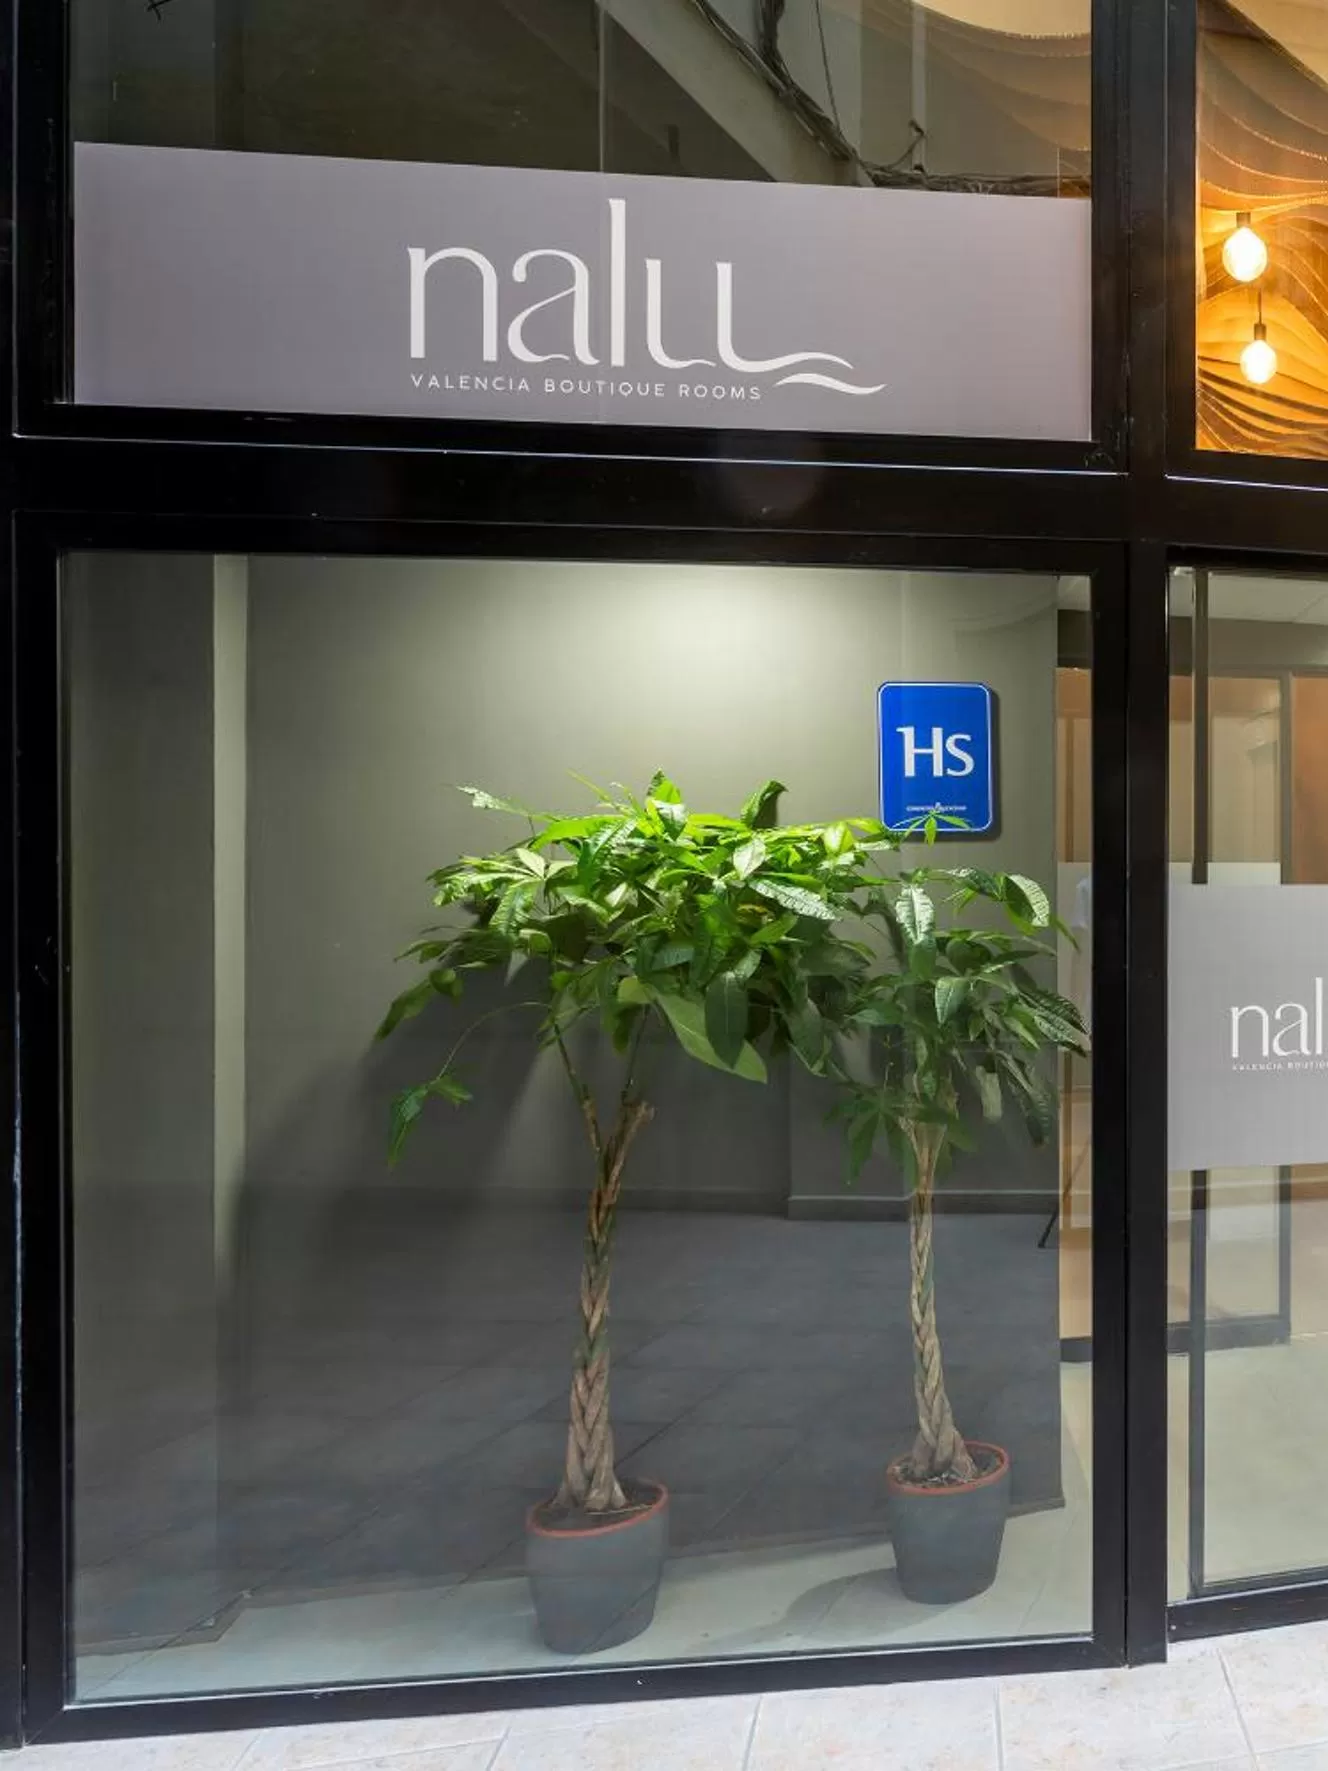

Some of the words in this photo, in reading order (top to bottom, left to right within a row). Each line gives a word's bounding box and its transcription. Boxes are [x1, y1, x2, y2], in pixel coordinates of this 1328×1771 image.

[407, 198, 855, 374] nalu
[410, 374, 530, 392] VALENCIA
[544, 378, 666, 397] BOUTIQUE
[679, 383, 762, 400] ROOMS
[896, 726, 975, 777] HS
